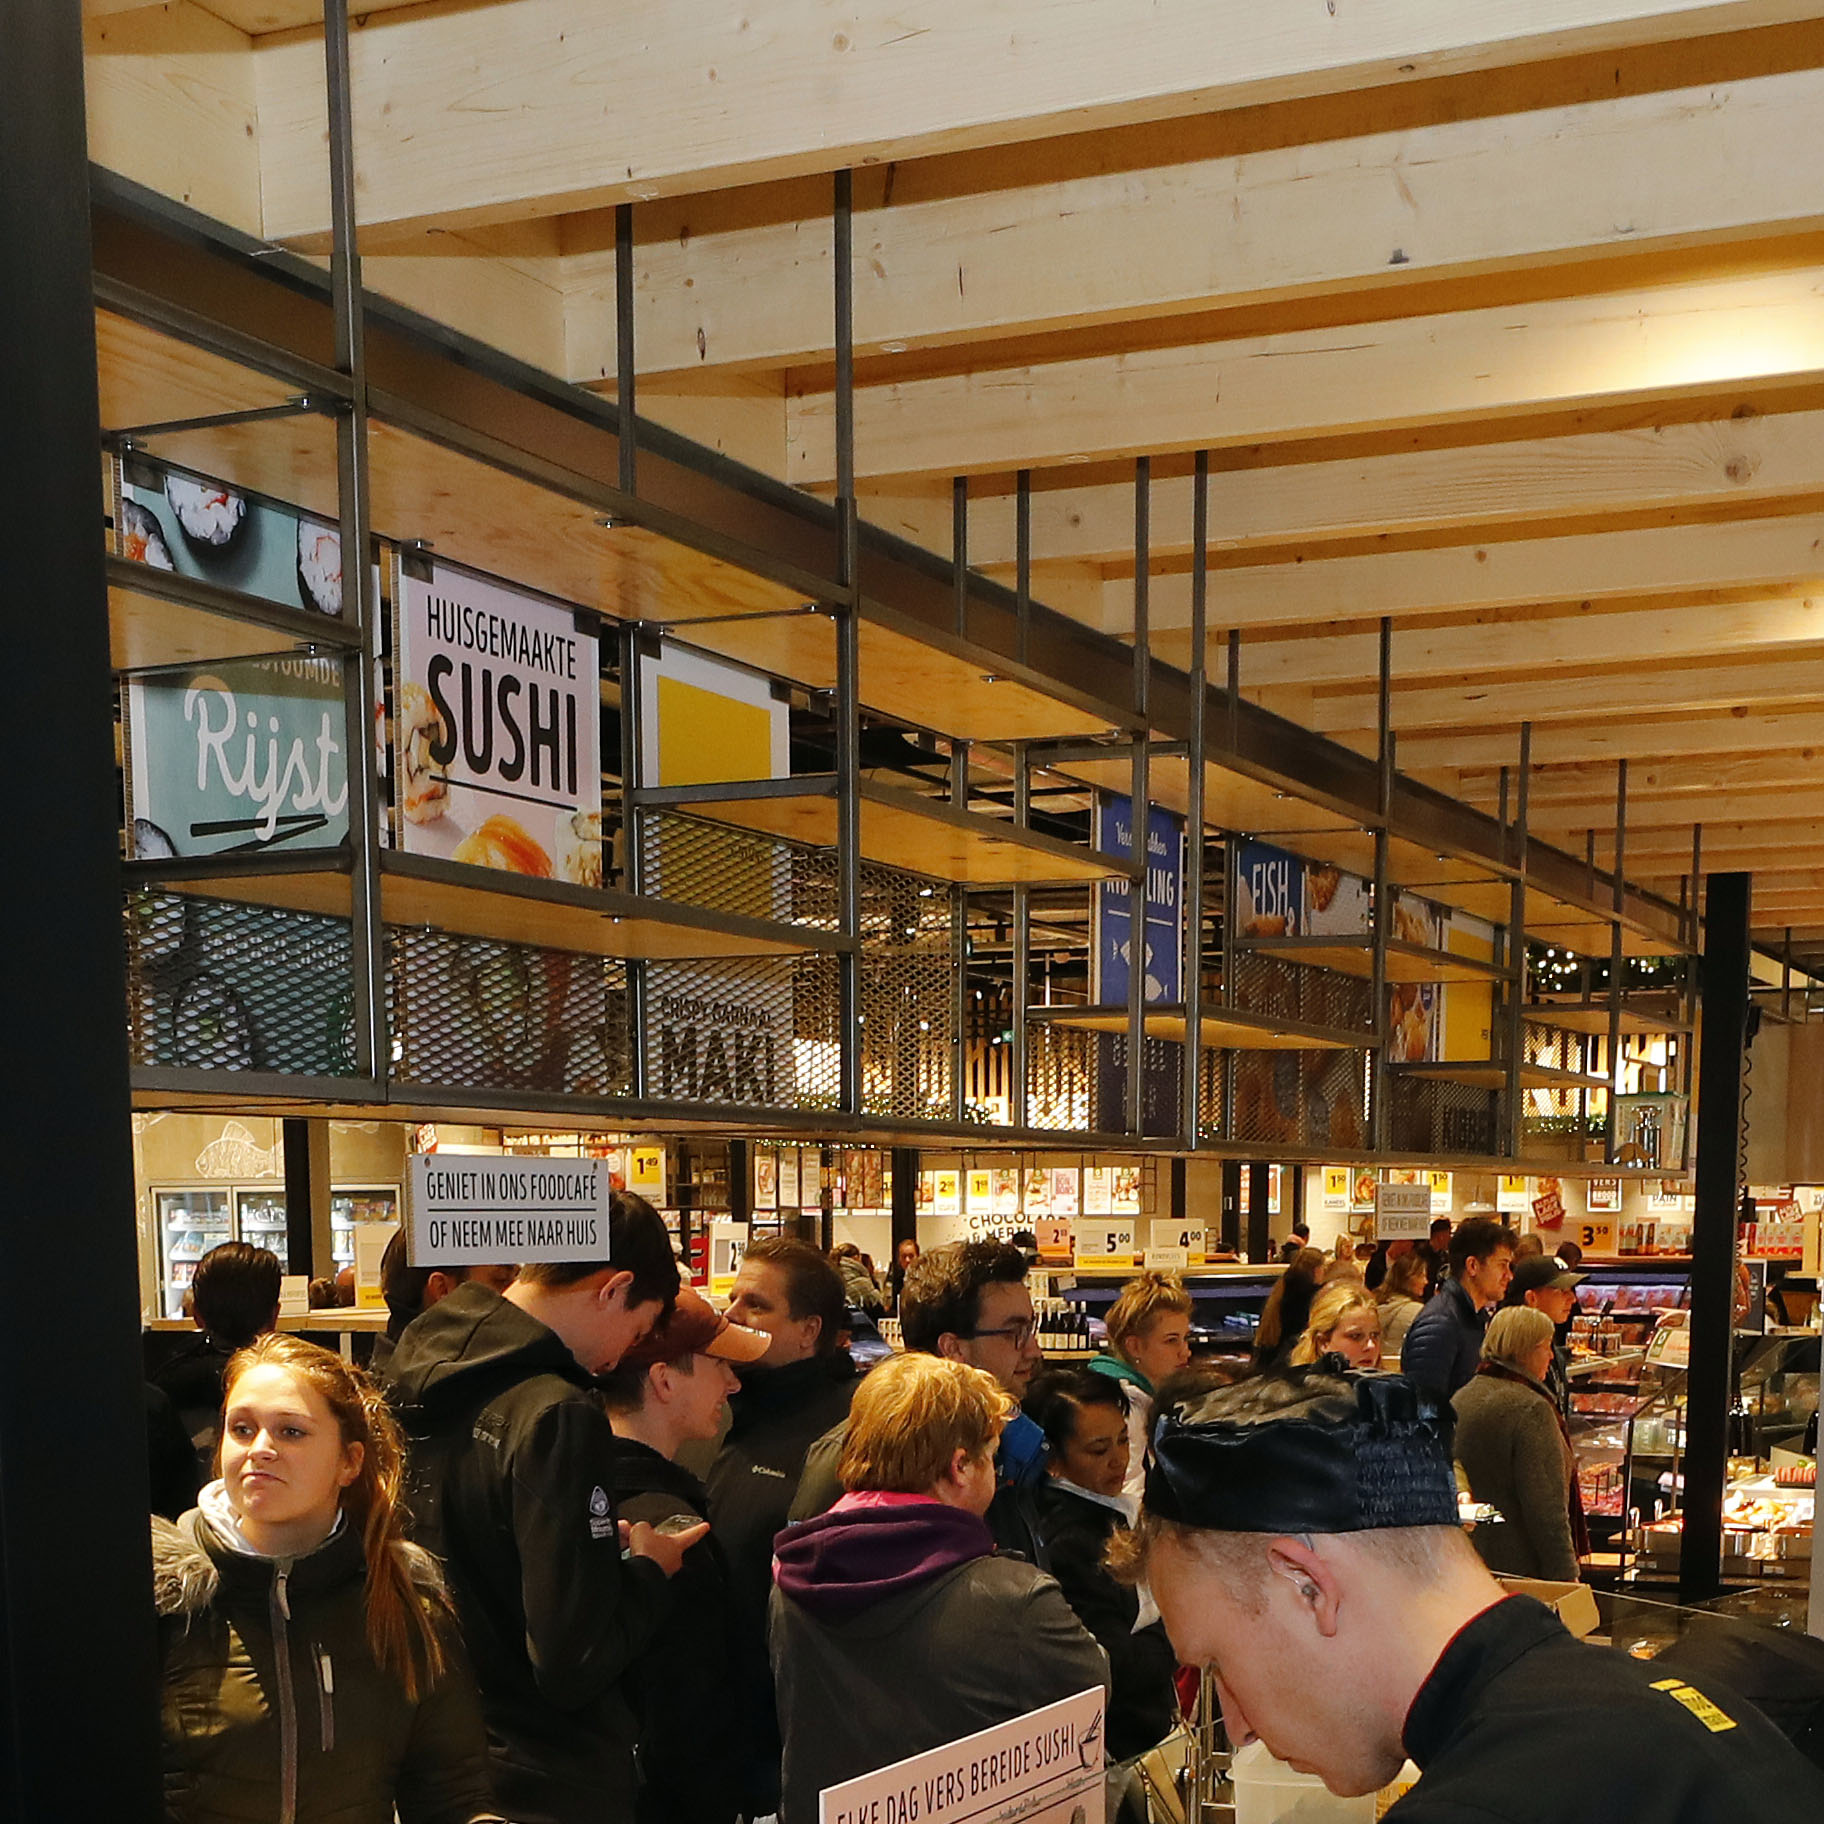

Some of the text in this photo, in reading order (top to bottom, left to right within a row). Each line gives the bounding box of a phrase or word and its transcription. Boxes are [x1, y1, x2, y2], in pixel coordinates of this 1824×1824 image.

[428, 594, 577, 680] HUISGEMAAKTE
[184, 674, 349, 842] Rijst
[428, 653, 578, 796] SUSHI
[1252, 860, 1290, 918] FISH
[427, 1170, 597, 1201] GENIET IN ONS FOODCAFÉ
[430, 1219, 597, 1248] OF NEEM MEE NAAR HUIS
[924, 1766, 965, 1815] VERS
[970, 1744, 1031, 1797] BEREIDE
[1035, 1722, 1075, 1770] SUSHI
